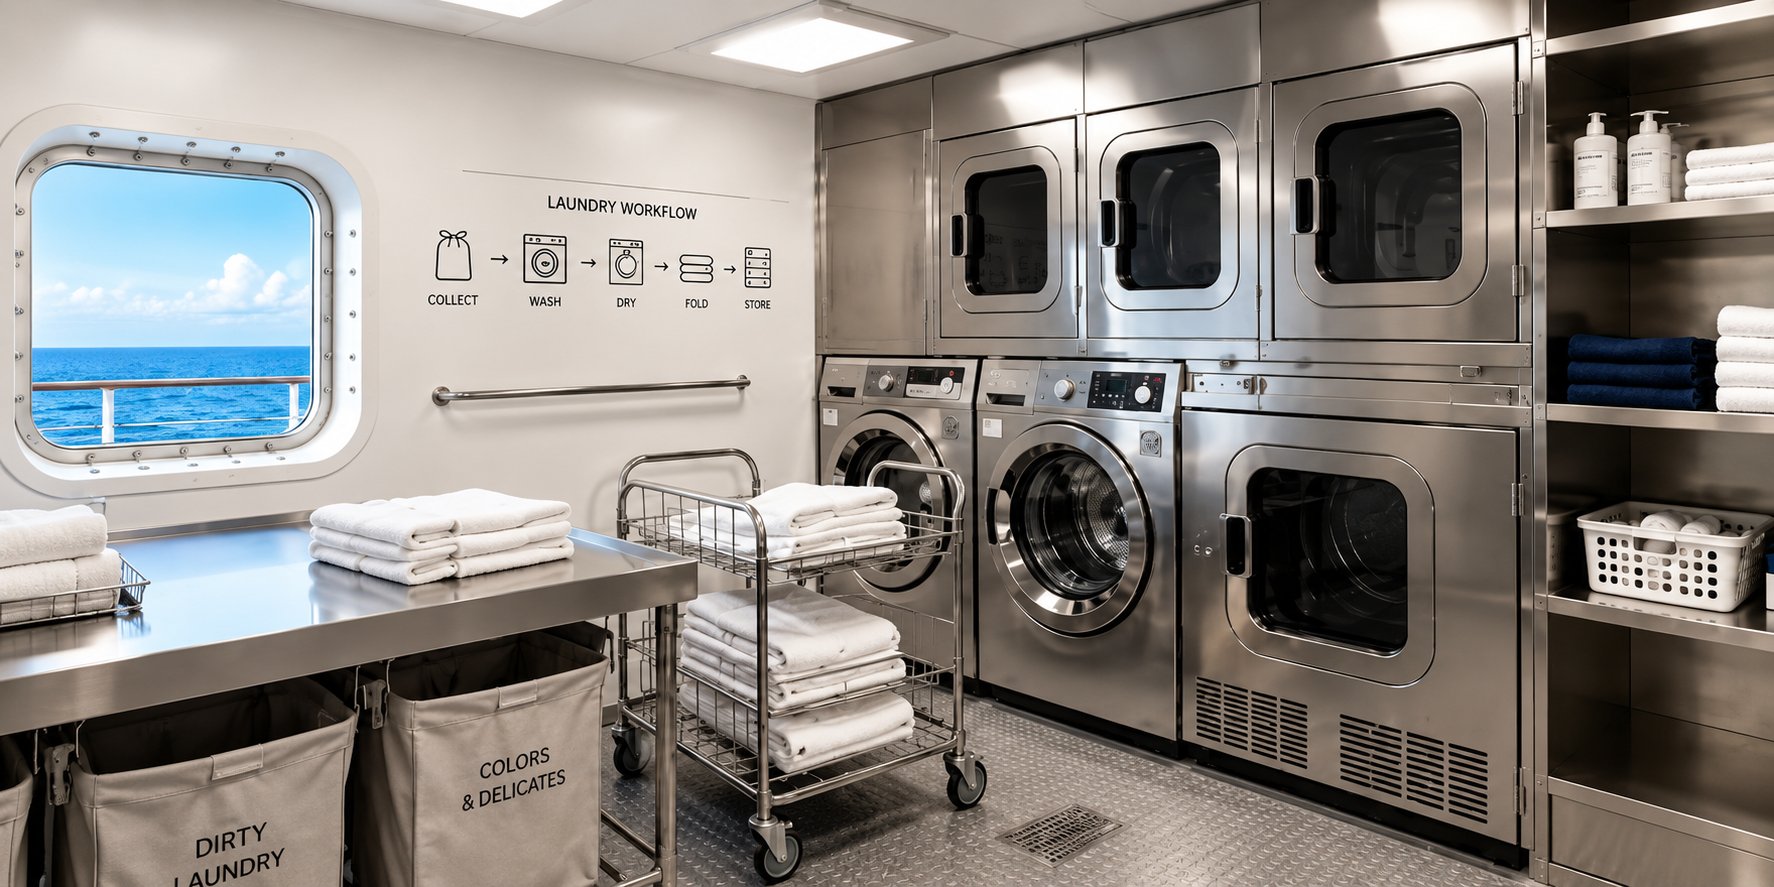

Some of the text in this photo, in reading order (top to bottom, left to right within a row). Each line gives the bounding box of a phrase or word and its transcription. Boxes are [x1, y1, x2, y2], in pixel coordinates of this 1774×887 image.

[548, 195, 697, 220] LAUNDRY WORKFLOW
[427, 294, 479, 306] COLLECT
[529, 296, 562, 307] WASH
[616, 297, 637, 308] DRY
[685, 298, 709, 309] FOLD
[744, 299, 771, 310] STORE
[479, 747, 550, 779] COLORS
[461, 769, 566, 812] & DELICATES
[196, 821, 267, 859] DIRTY
